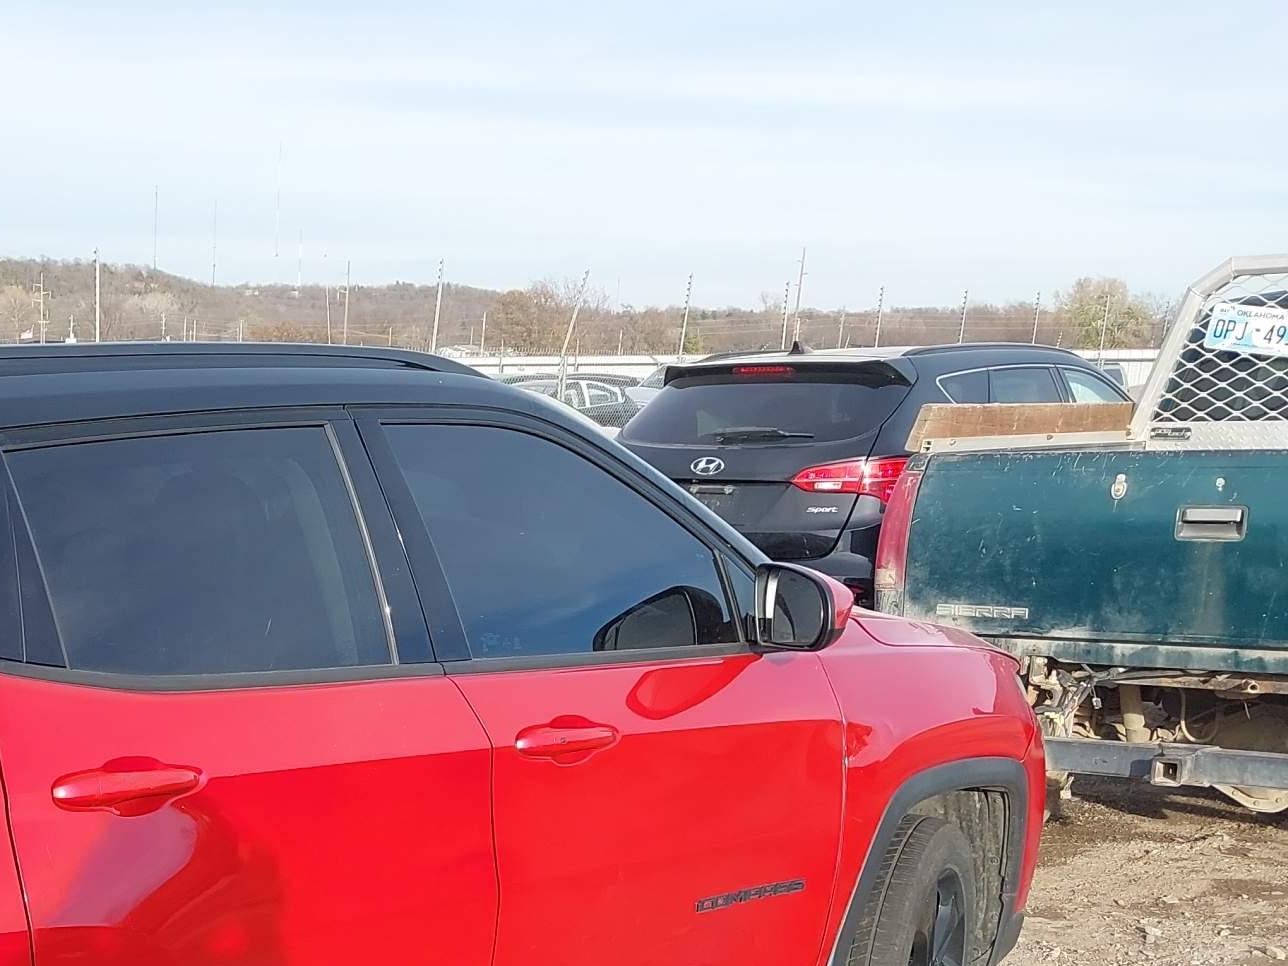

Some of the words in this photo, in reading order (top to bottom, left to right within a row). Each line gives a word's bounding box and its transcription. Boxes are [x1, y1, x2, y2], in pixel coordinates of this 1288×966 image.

[1237, 309, 1285, 320] OKLAHOMA
[806, 506, 839, 514] Sport
[936, 603, 1029, 619] SIERRA
[696, 879, 806, 913] COMPASS
